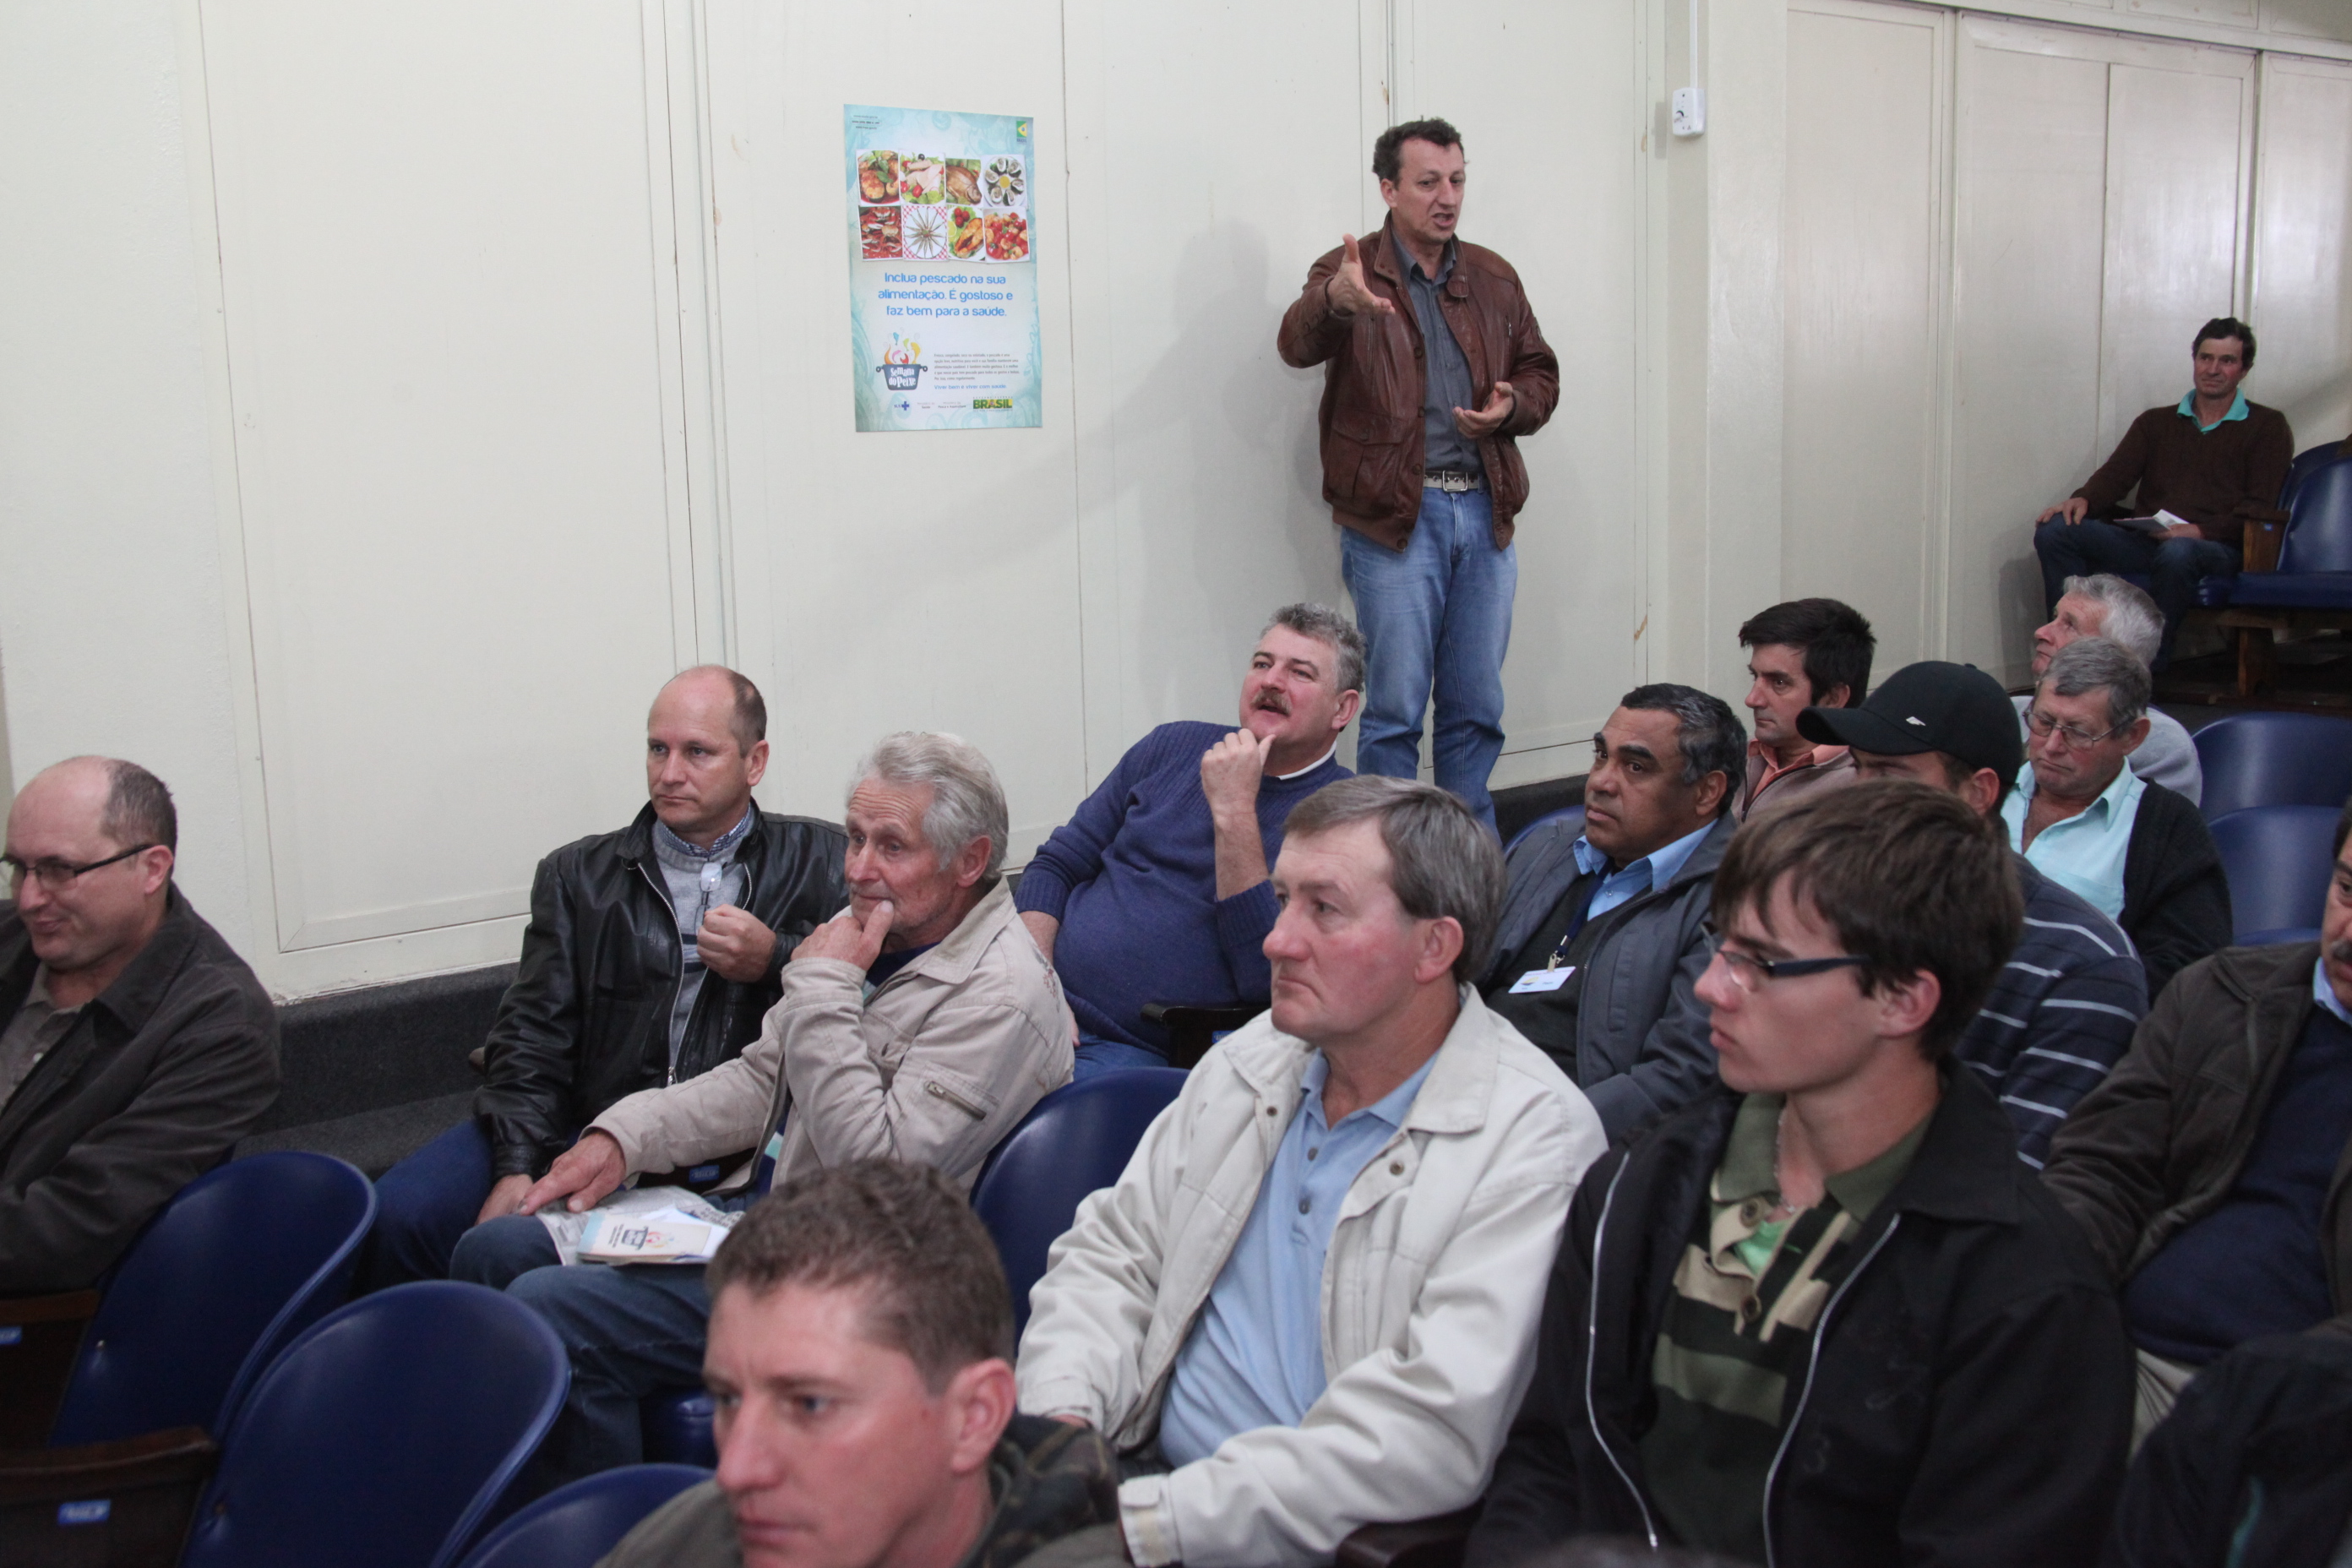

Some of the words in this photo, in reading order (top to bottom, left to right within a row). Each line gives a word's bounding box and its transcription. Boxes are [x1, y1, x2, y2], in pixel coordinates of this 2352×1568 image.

[885, 272, 917, 283] Inclua
[919, 274, 967, 286] pescado
[971, 275, 983, 284] na
[986, 275, 1006, 284] sua
[878, 289, 946, 301] alimentação.
[949, 287, 957, 300] É
[960, 291, 1004, 302] gostoso
[886, 305, 904, 316] faz
[906, 305, 933, 316] bem
[935, 308, 960, 318] para
[962, 308, 970, 316] a
[972, 306, 1007, 317] saúde.
[896, 375, 917, 389] Peixe
[973, 399, 1013, 409] BRASIL
